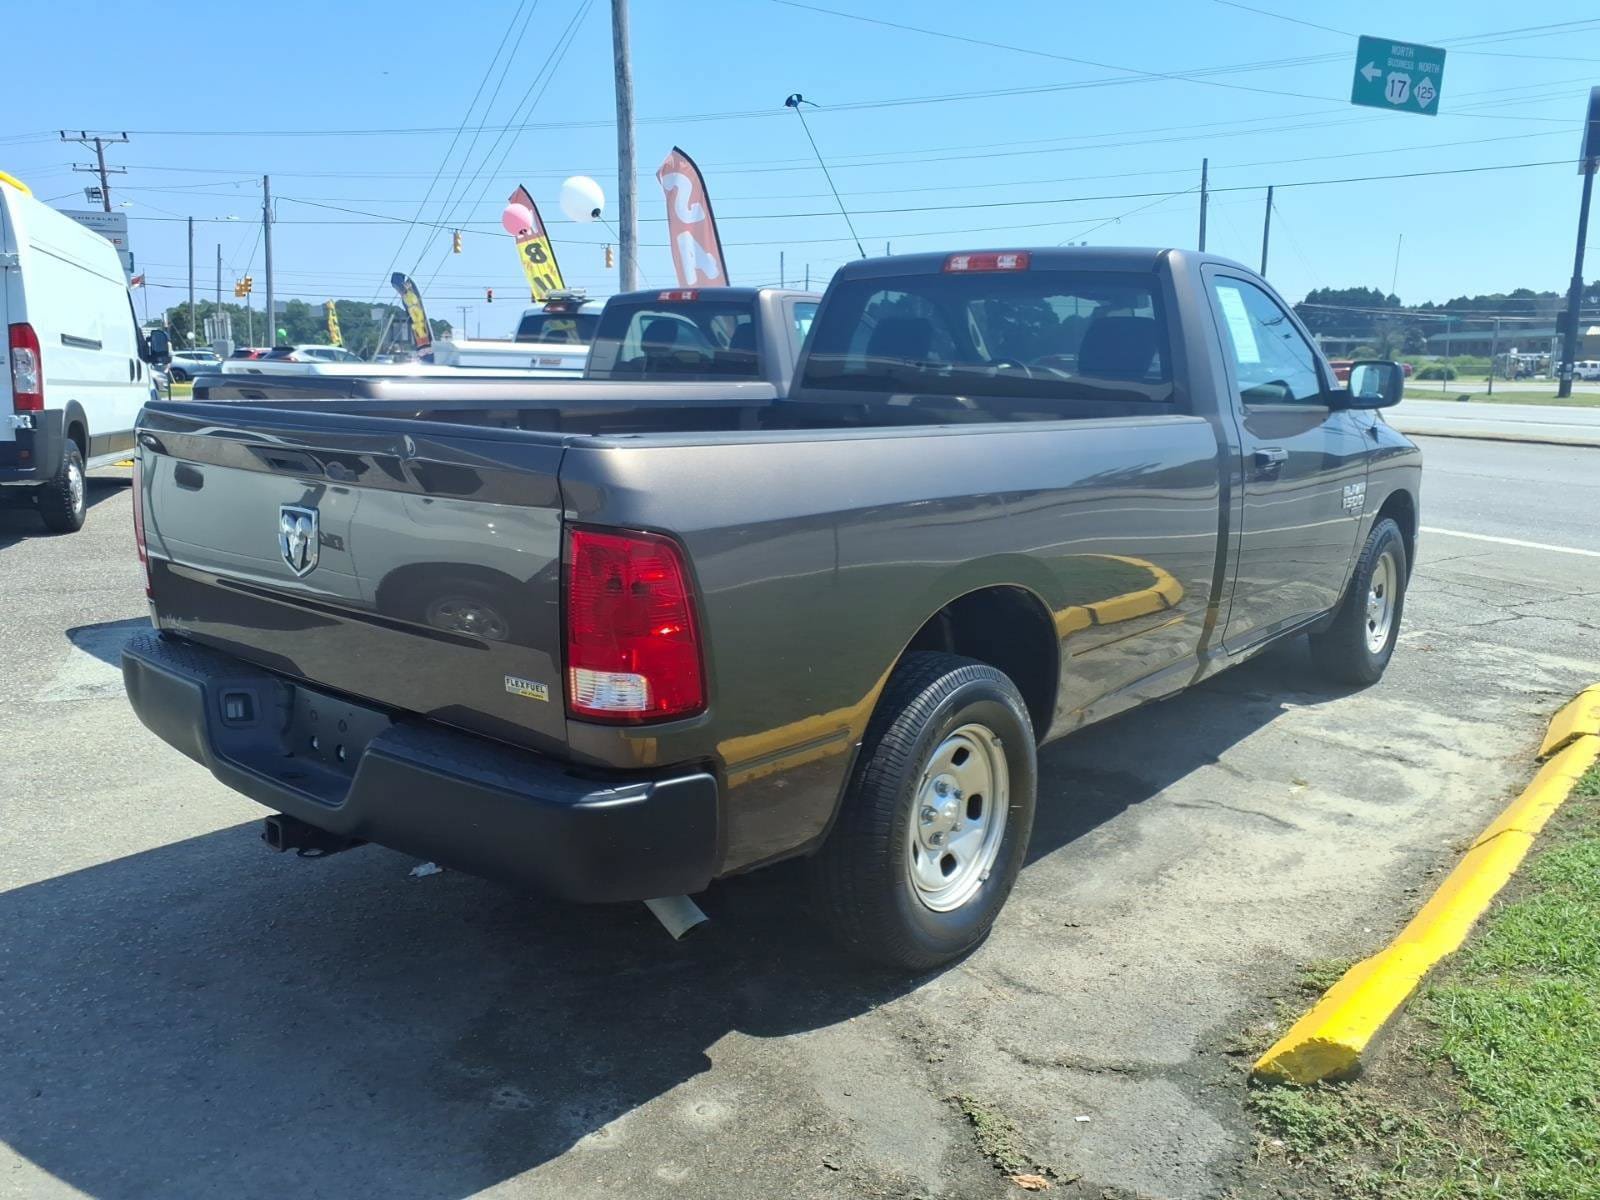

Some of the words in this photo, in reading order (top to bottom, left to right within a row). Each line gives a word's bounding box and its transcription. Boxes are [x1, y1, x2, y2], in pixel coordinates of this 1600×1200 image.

[1391, 45, 1414, 57] NORTH
[1418, 61, 1440, 73] NORTH
[1390, 79, 1407, 98] 17
[1417, 86, 1433, 99] 125
[1343, 494, 1365, 509] 1500
